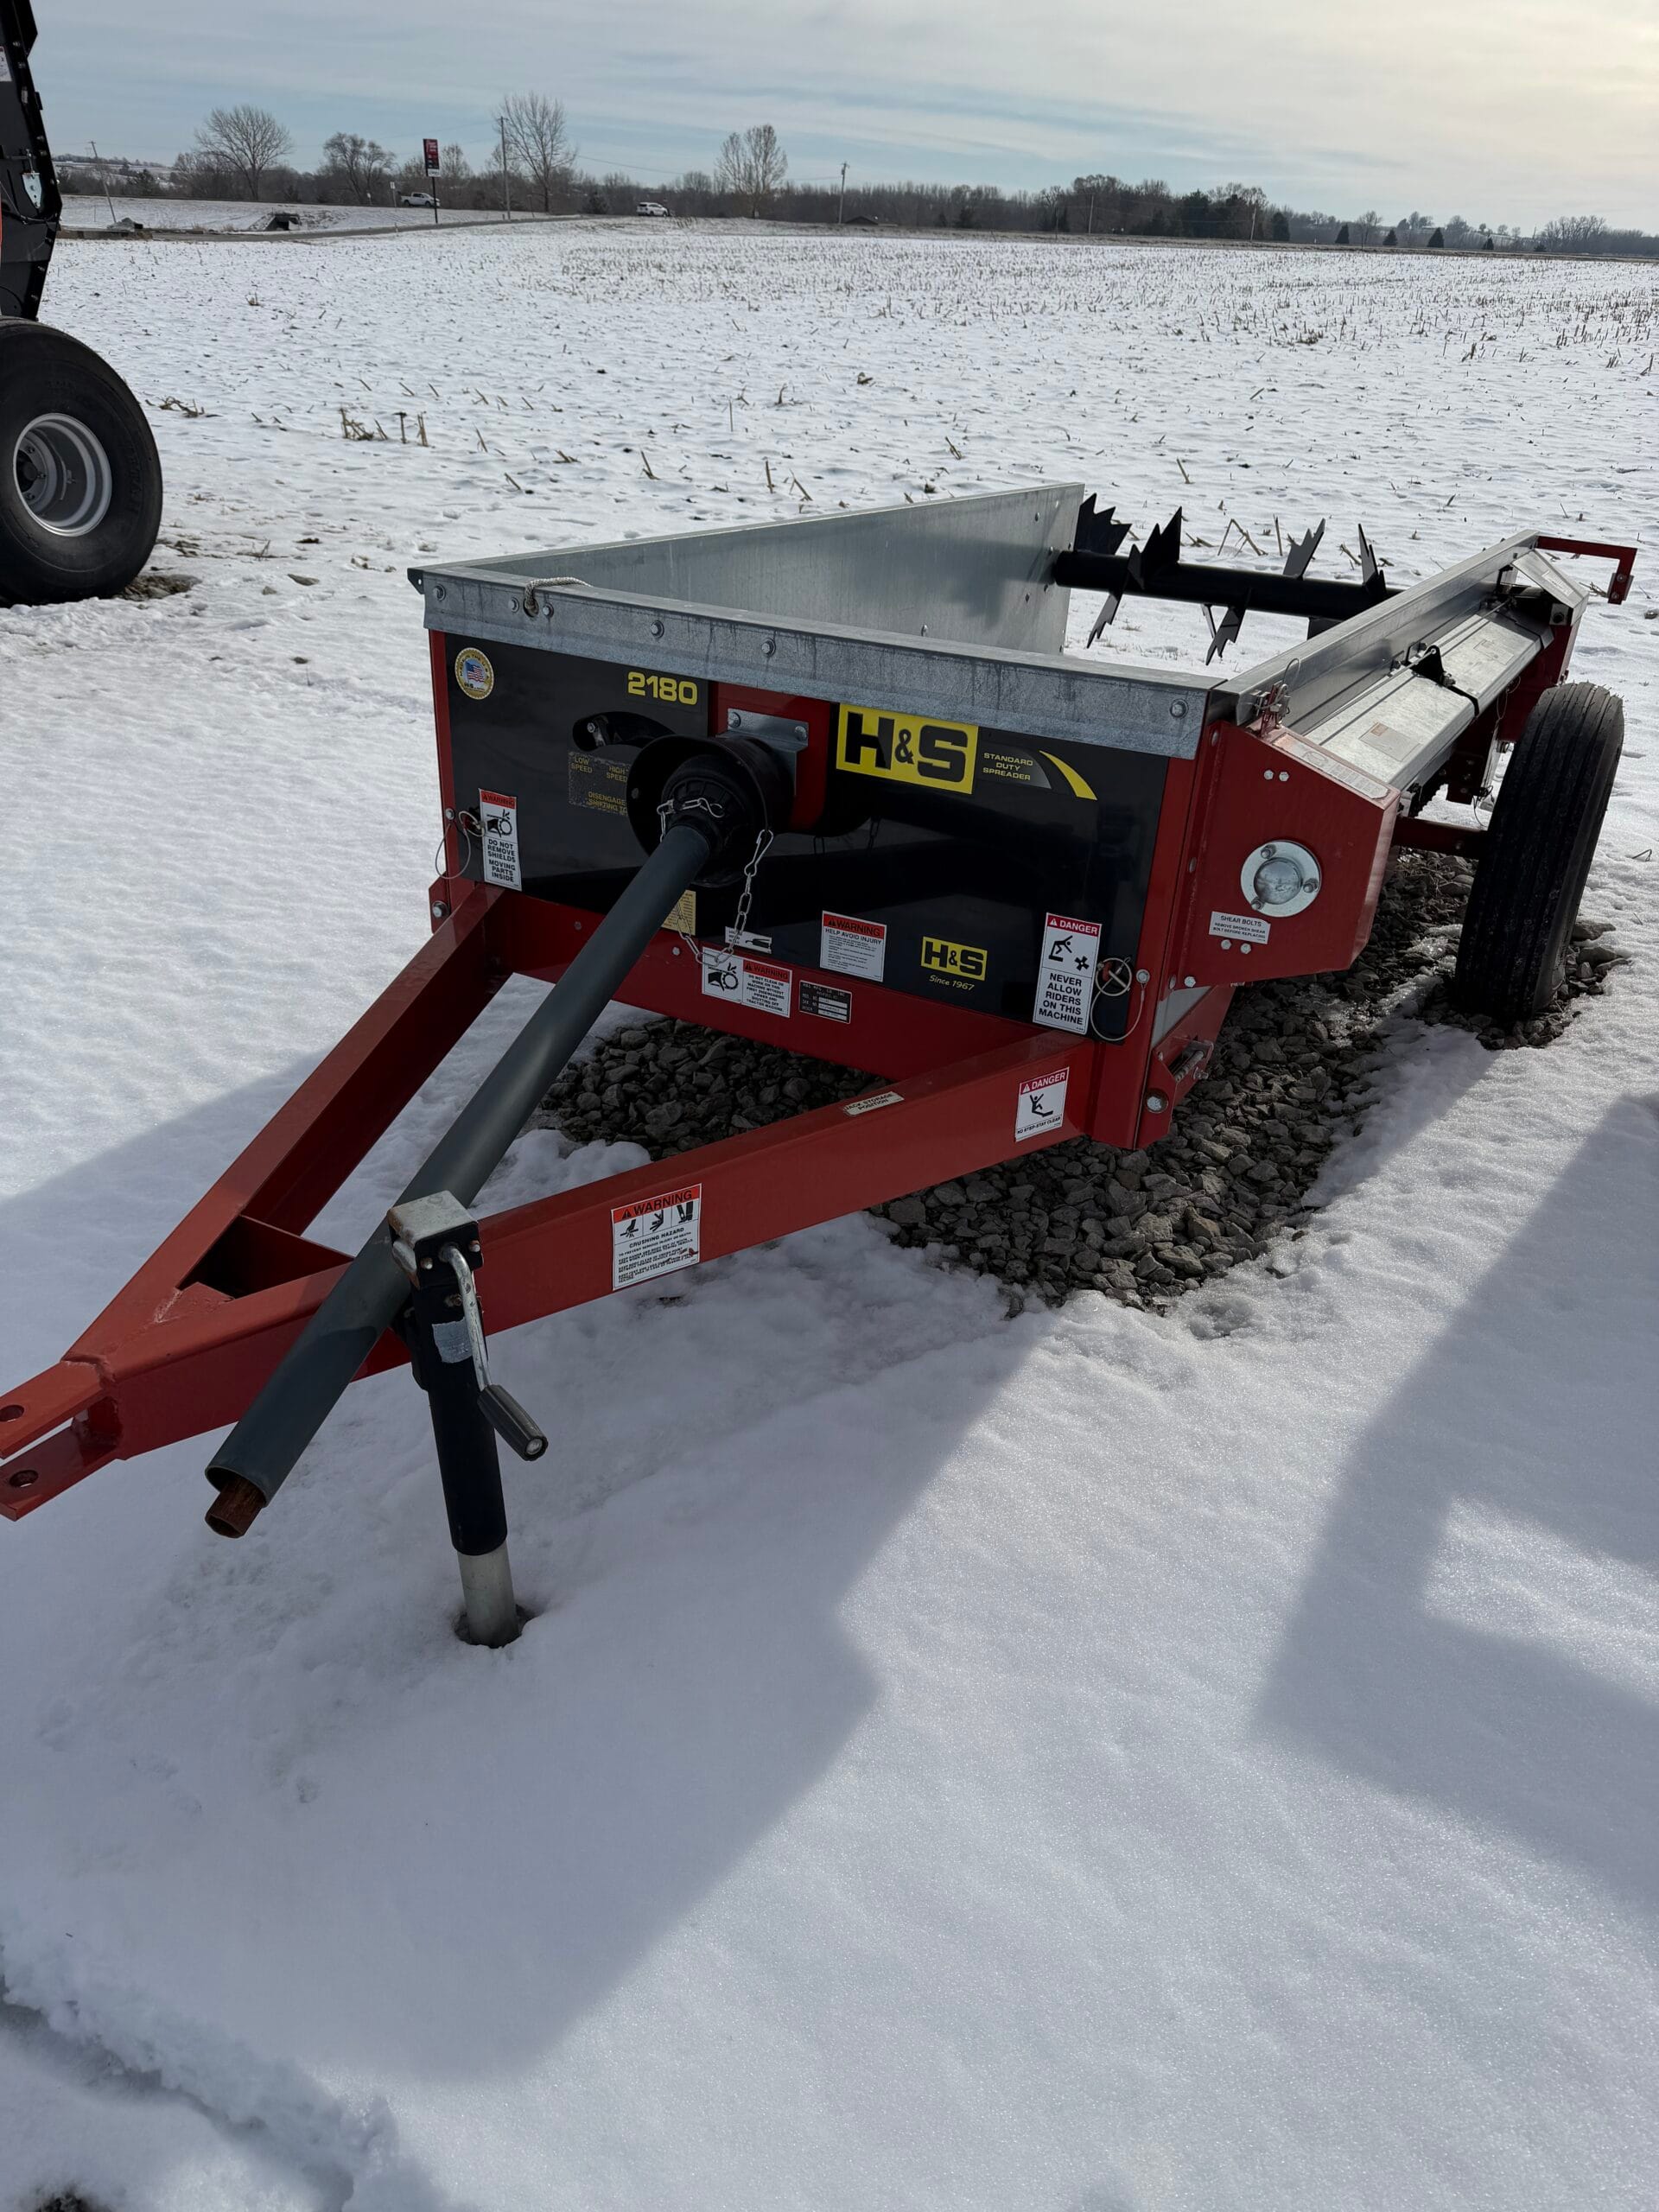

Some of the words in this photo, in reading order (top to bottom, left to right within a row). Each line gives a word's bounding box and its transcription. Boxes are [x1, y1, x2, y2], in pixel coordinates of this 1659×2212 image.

[628, 671, 697, 705] 2180
[845, 711, 968, 783] H&S
[575, 755, 589, 765] LOW
[983, 753, 1033, 766] STANDARD
[570, 763, 593, 773] SPEED
[608, 766, 626, 775] HIGH
[995, 762, 1020, 771] DUTY
[607, 772, 627, 783] SPEED
[982, 767, 1030, 781] SPREADER
[487, 794, 514, 807] WARNING
[488, 845, 515, 856] REMOVE
[488, 851, 515, 862] SHIELDS
[489, 860, 515, 870] MOVING
[493, 866, 513, 876] PARTS
[492, 872, 514, 882] INSIDE
[836, 919, 880, 936] WARNING
[1059, 920, 1097, 935] DANGER
[842, 931, 859, 940] AVOID
[861, 936, 881, 944] INJURY
[925, 941, 983, 976] H&S
[753, 965, 788, 979] WARNING
[929, 975, 950, 985] Since
[952, 981, 975, 990] 1967
[1050, 973, 1082, 986] NEVER
[1047, 982, 1082, 995] ALLOW
[1046, 991, 1081, 1006] RIDERS
[1043, 1001, 1056, 1009] ON
[1059, 1004, 1081, 1015] THIS
[1039, 1007, 1083, 1025] MACHINE
[1032, 1071, 1065, 1089] DANGER
[858, 1099, 888, 1109] POSITION
[863, 1094, 893, 1103] STORAGE
[633, 1190, 692, 1215] WARNING
[629, 1236, 659, 1249] CRUSHING
[661, 1227, 684, 1237] HAZARD
